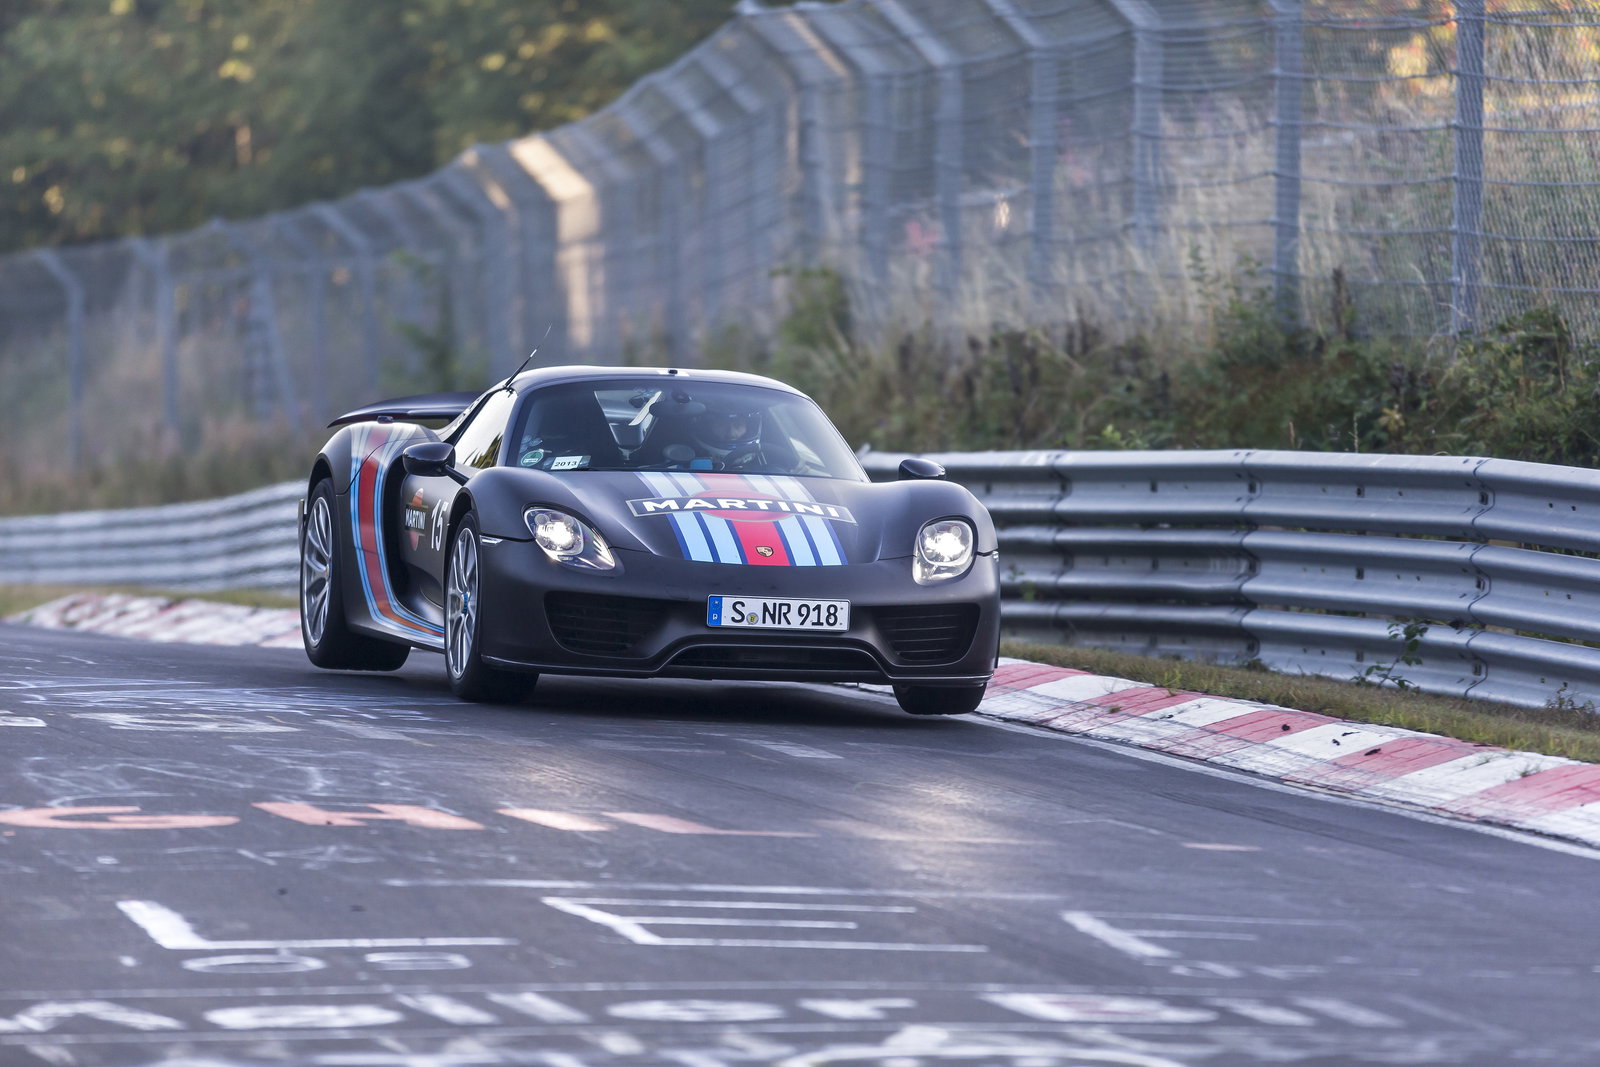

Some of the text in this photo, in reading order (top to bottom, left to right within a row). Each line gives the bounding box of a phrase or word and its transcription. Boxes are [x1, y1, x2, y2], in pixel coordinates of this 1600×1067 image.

[405, 508, 426, 530] MARTINI
[642, 498, 840, 518] MARTINI
[431, 499, 449, 552] 15
[731, 600, 839, 627] S NR 918
